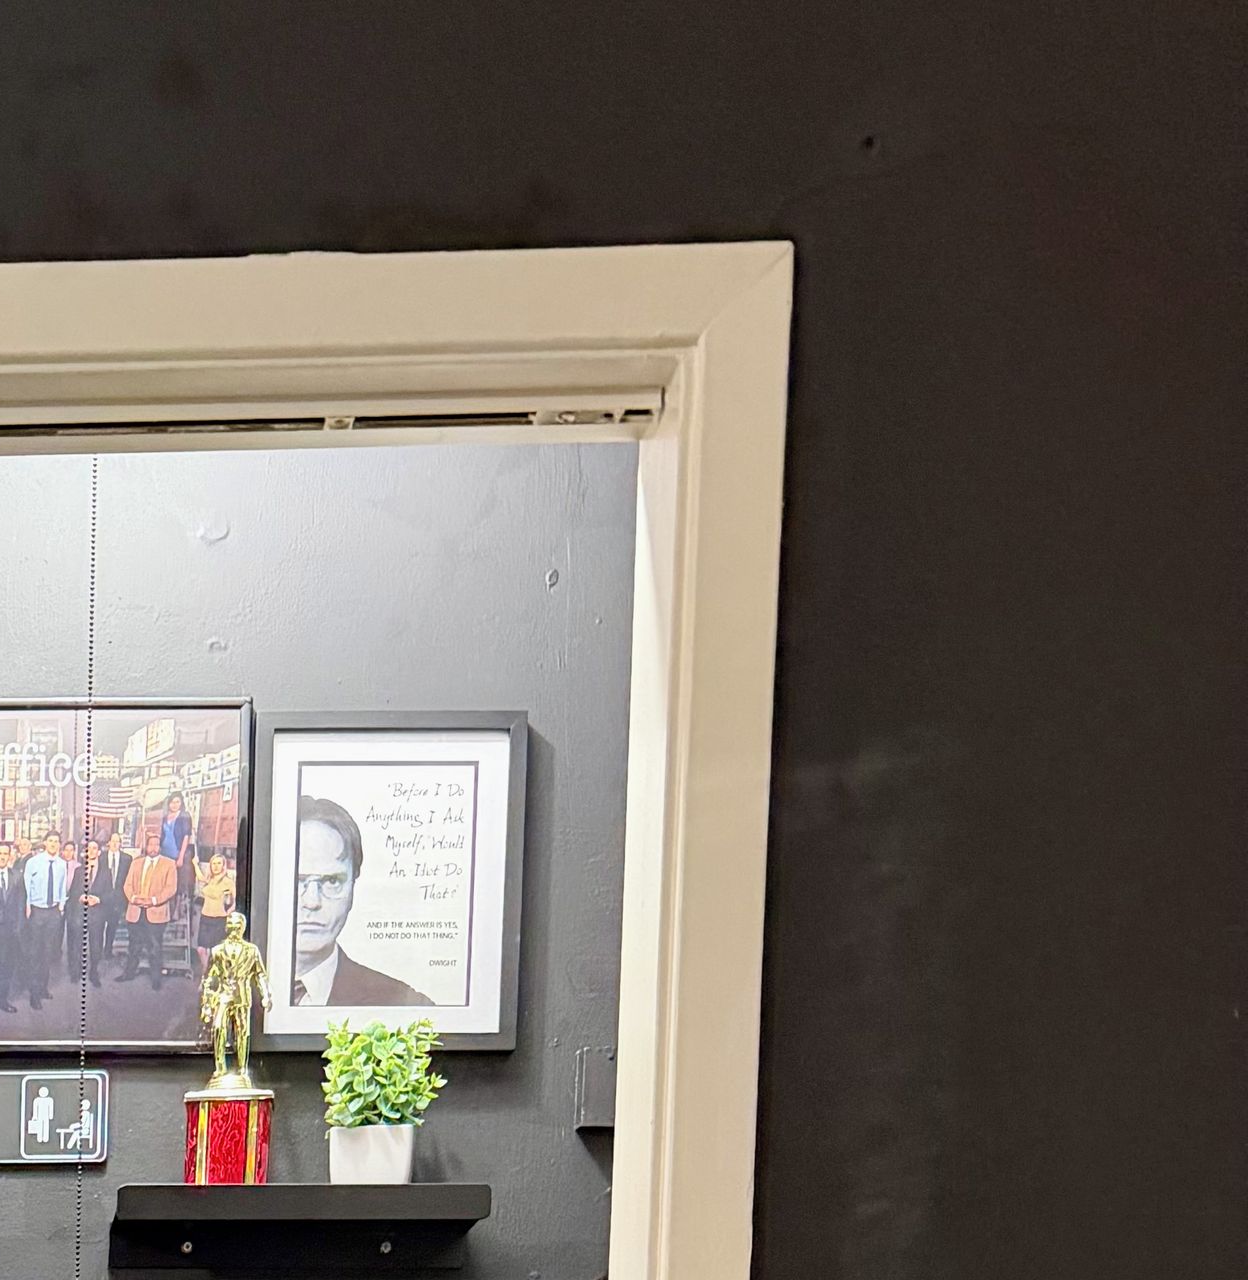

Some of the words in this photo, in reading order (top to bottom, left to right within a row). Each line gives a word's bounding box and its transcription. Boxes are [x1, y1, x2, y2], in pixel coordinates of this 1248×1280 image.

[434, 783, 442, 796] I
[447, 783, 465, 797] Do
[429, 810, 436, 824] I
[389, 861, 406, 878] An
[444, 862, 463, 877] Do
[366, 921, 383, 929] AND
[383, 921, 389, 929] IF
[391, 921, 404, 929] THE
[405, 921, 435, 929] ANSWER
[436, 921, 443, 929] IS
[373, 932, 384, 940] DO
[385, 932, 399, 940] NOT
[400, 932, 412, 940] DO
[413, 932, 430, 940] THAT
